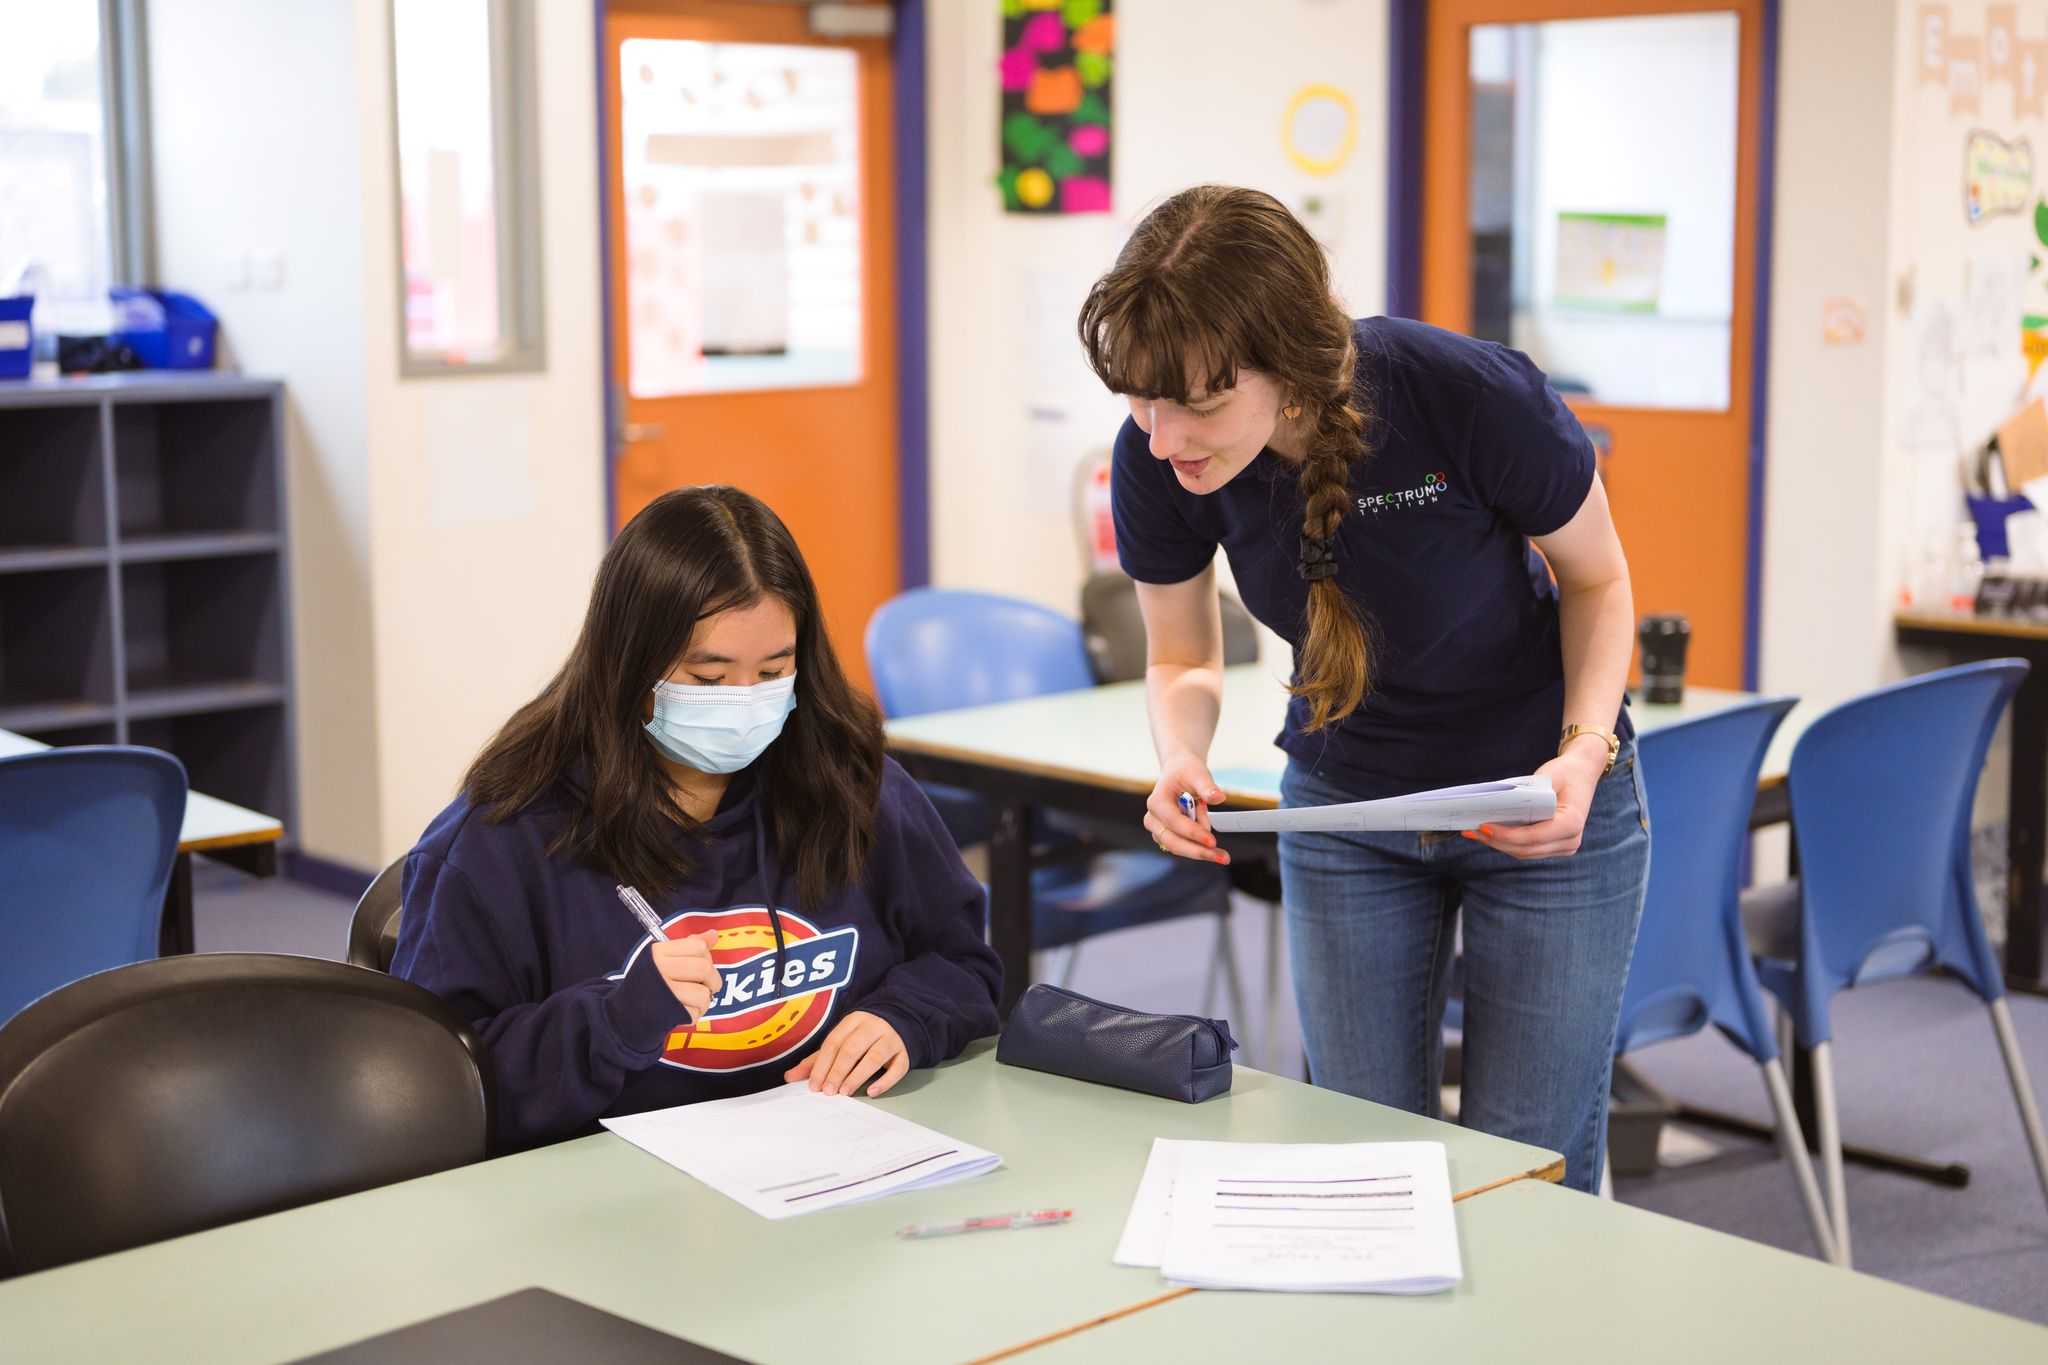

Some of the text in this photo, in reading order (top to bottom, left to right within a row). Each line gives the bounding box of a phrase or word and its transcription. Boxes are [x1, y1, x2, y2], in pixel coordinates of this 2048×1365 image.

[1358, 484, 1436, 508] SPECTRUM
[1360, 496, 1438, 516] TUITION
[709, 950, 837, 1008] kies
